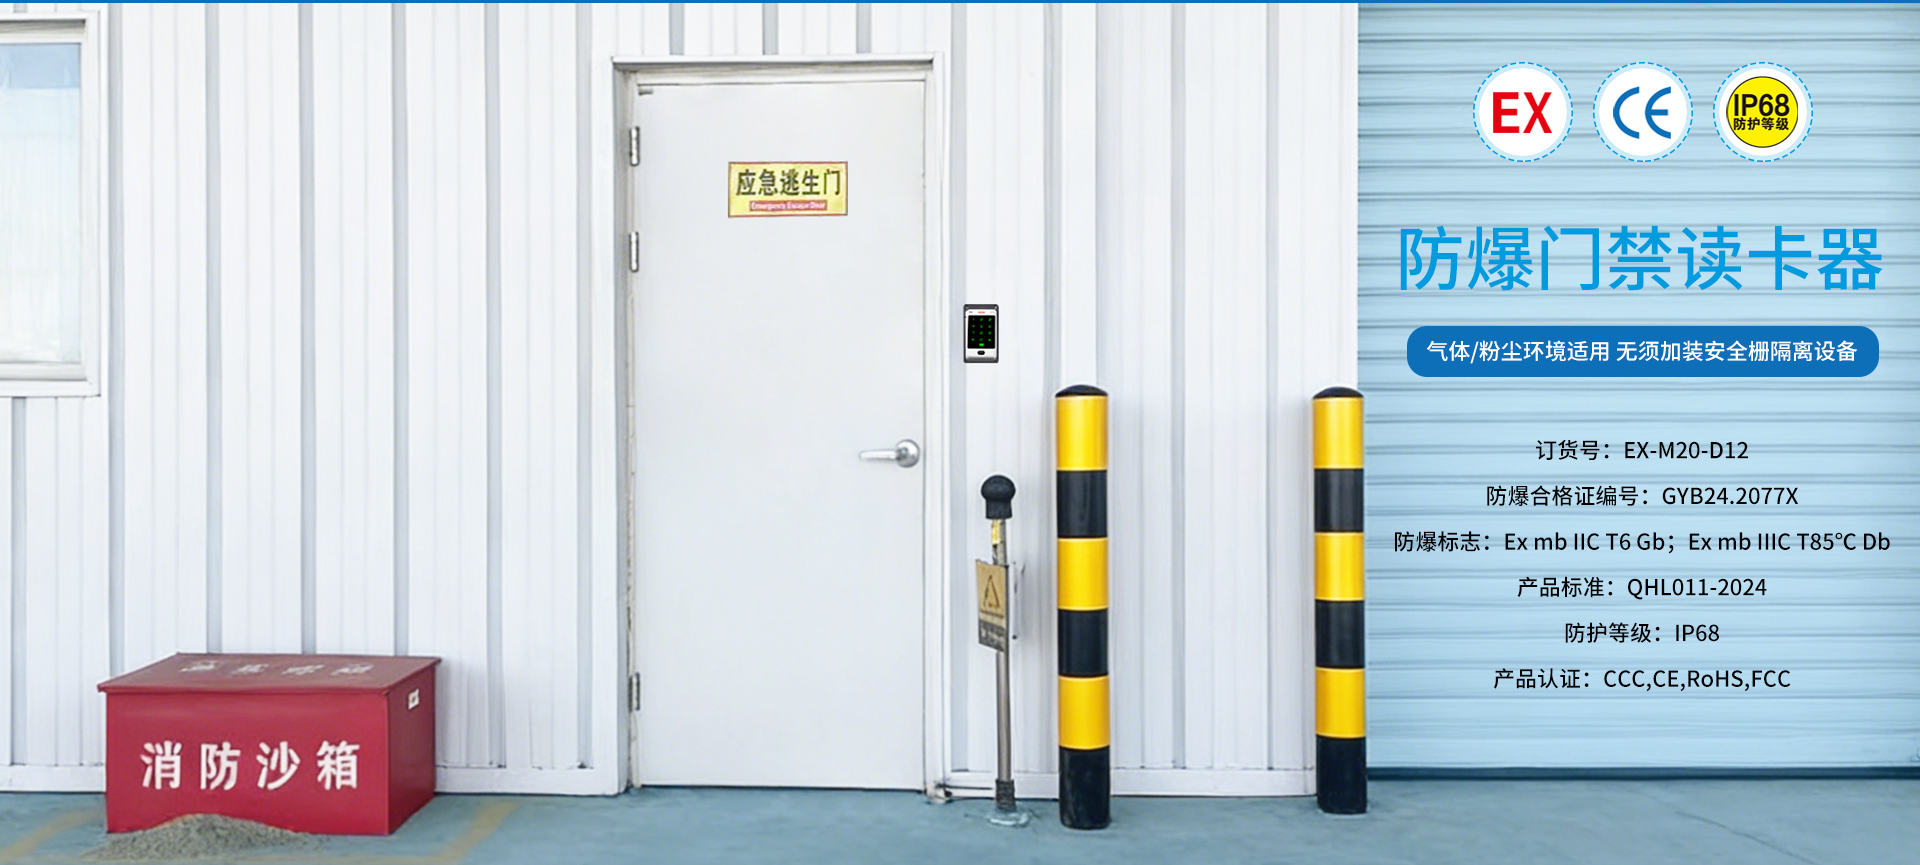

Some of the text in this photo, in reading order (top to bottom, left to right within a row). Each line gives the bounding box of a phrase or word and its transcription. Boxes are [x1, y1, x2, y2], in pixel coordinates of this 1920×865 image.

[736, 168, 841, 196] 应急逃生门
[140, 739, 360, 791] 消防沙箱
